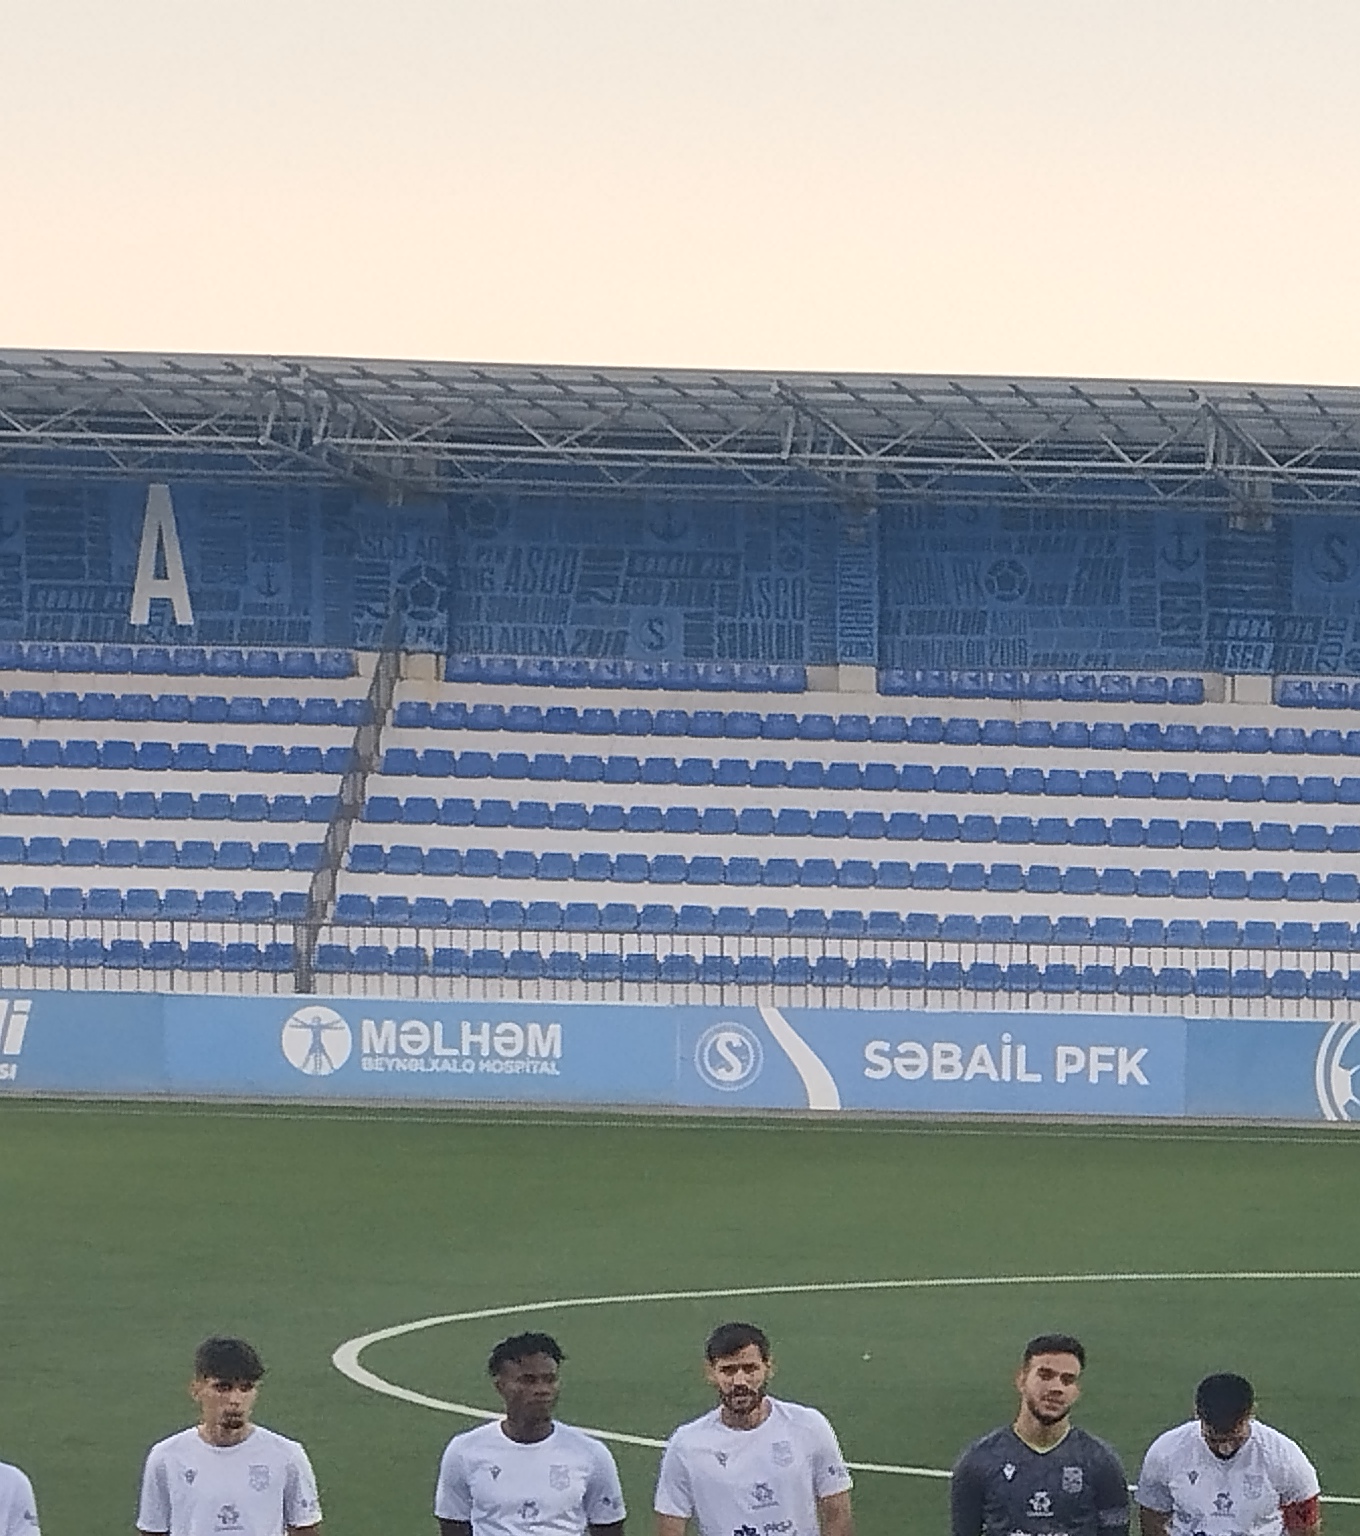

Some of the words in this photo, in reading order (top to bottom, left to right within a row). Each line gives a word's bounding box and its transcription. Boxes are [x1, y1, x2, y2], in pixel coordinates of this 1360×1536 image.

[362, 1019, 563, 1058] MƏLHƏM
[864, 1032, 1043, 1083] SƏBAİL
[1056, 1046, 1150, 1085] PFK
